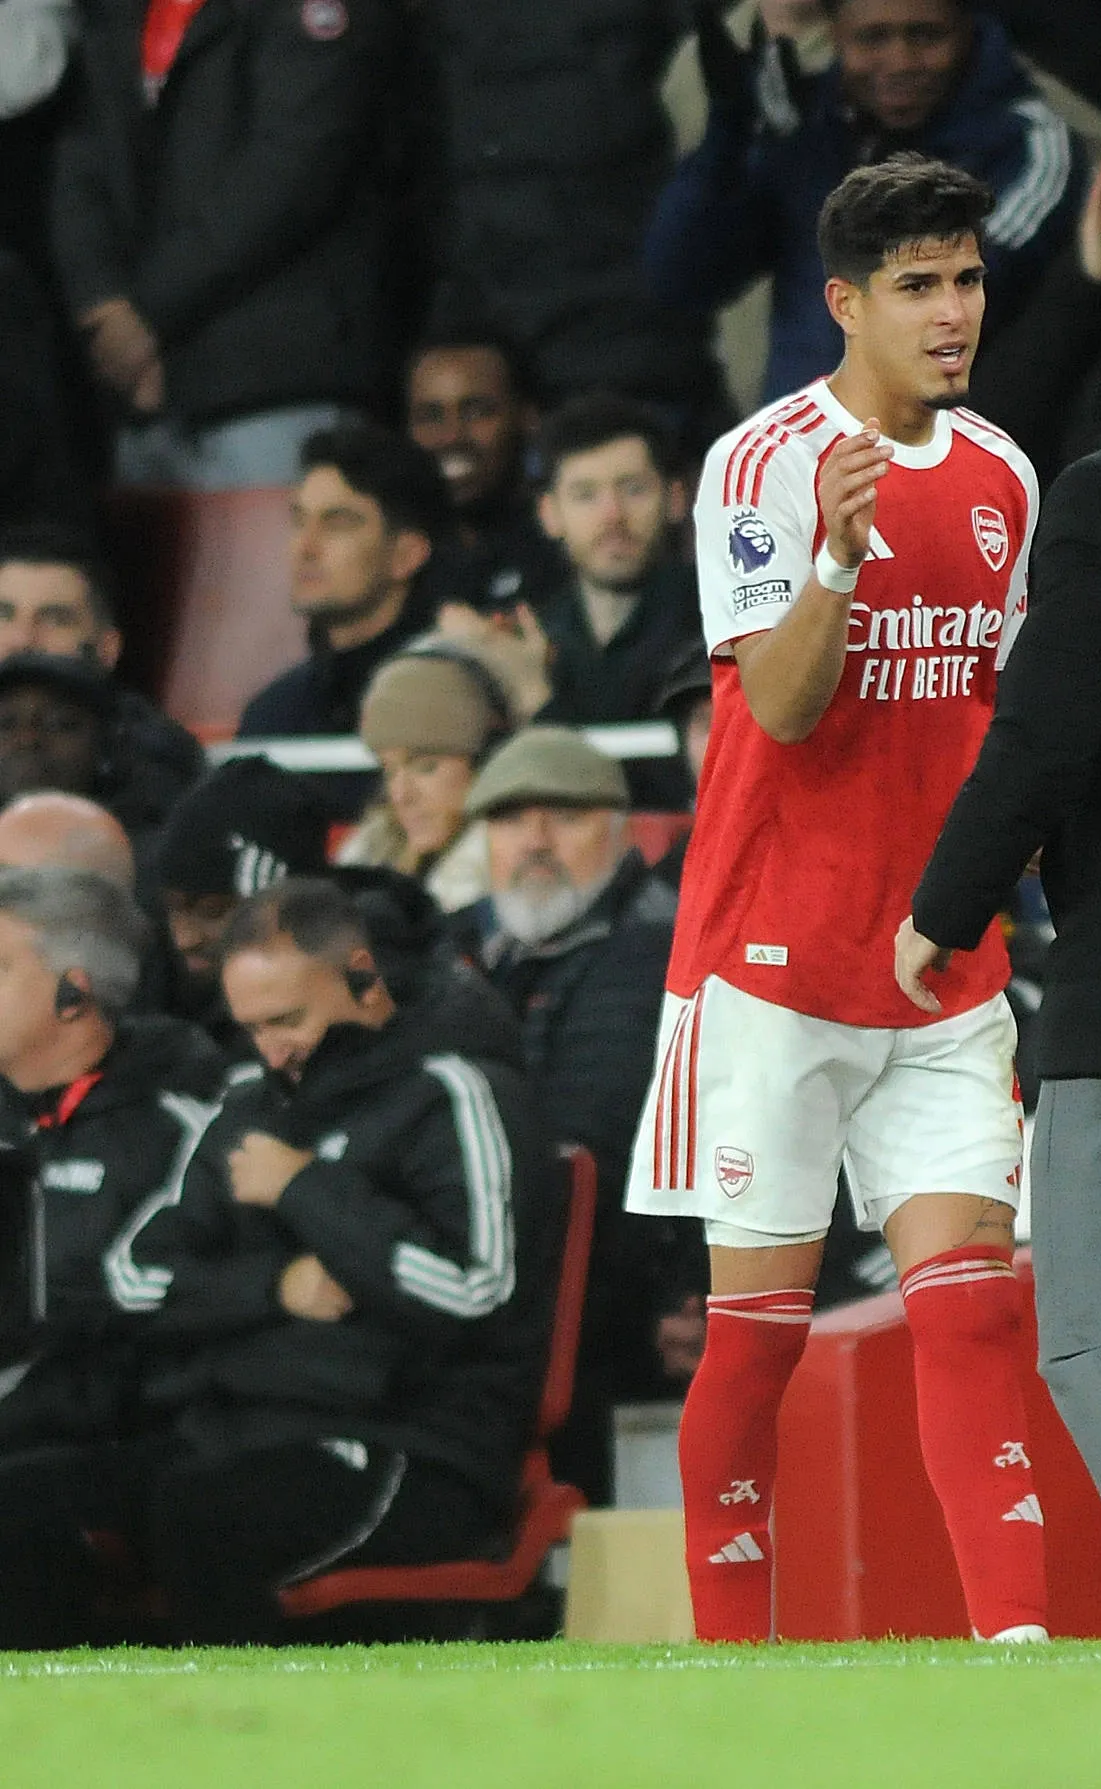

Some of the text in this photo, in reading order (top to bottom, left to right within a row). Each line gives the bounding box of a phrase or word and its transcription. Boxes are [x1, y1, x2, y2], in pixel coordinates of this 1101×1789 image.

[733, 592, 792, 614] or racism
[746, 581, 785, 598] room
[846, 594, 1004, 652] Emirate
[859, 655, 979, 700] FLY BETTE
